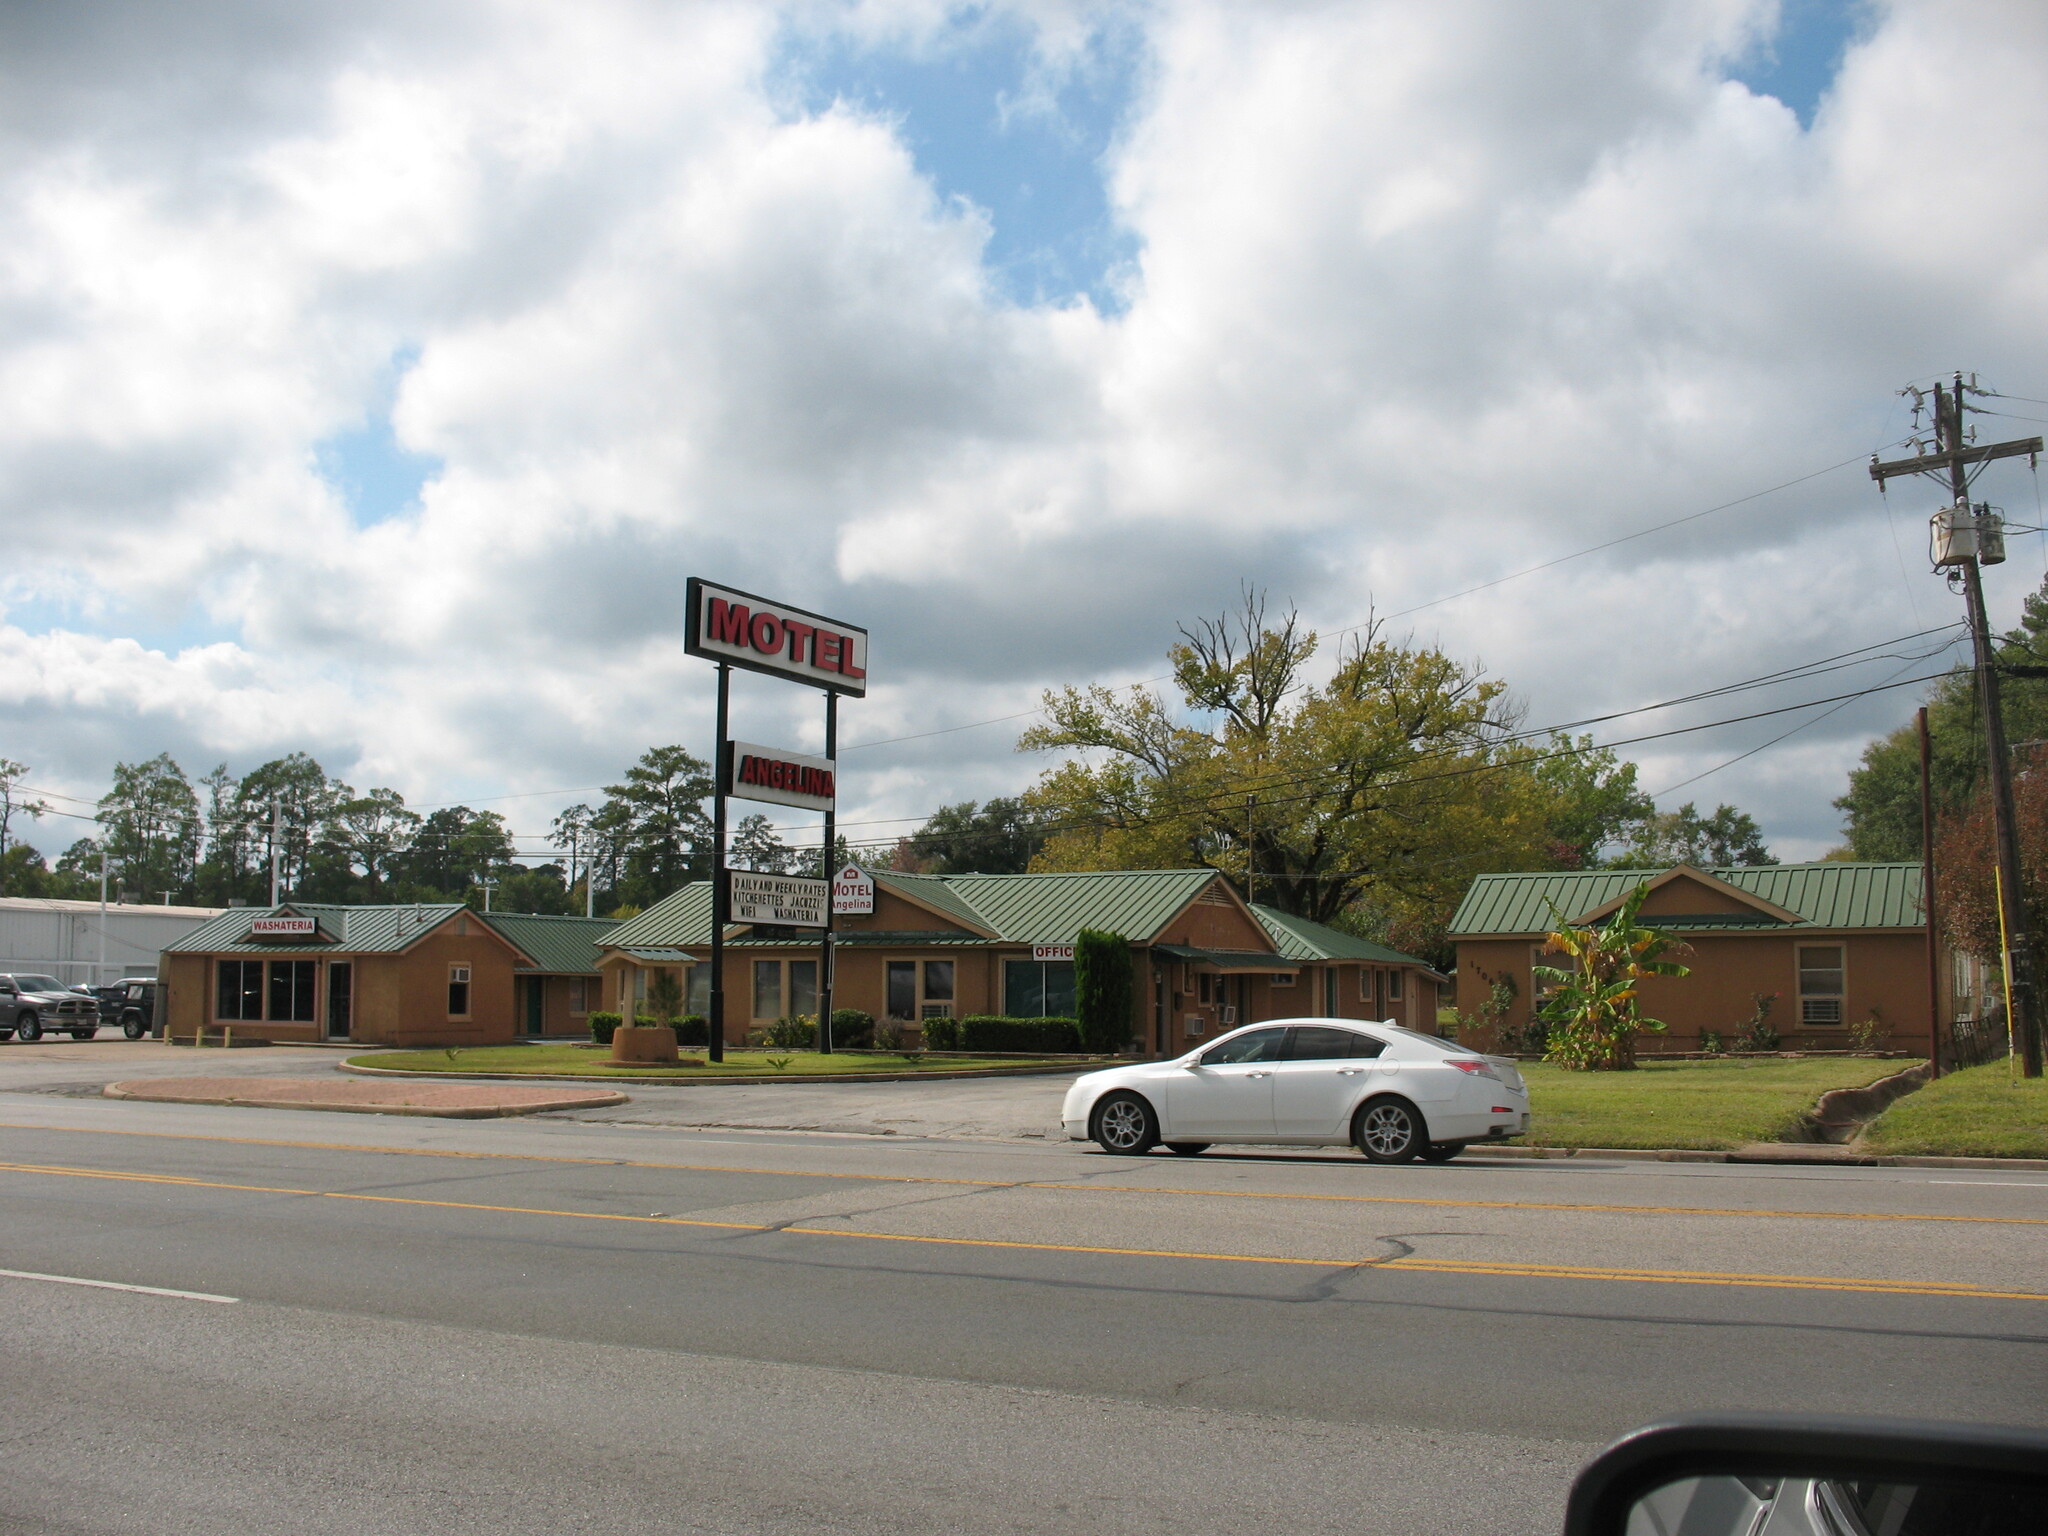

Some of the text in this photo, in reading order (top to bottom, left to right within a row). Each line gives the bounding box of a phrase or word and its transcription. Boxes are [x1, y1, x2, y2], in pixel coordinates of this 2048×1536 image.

[707, 597, 866, 679] MOTEL
[738, 755, 835, 798] ANGELINA
[734, 878, 826, 897] DAILY AND WEEKLY RATES
[733, 891, 784, 906] KITCHENETTES
[773, 907, 819, 922] WASHATERIA
[254, 921, 313, 931] WASHATERIA
